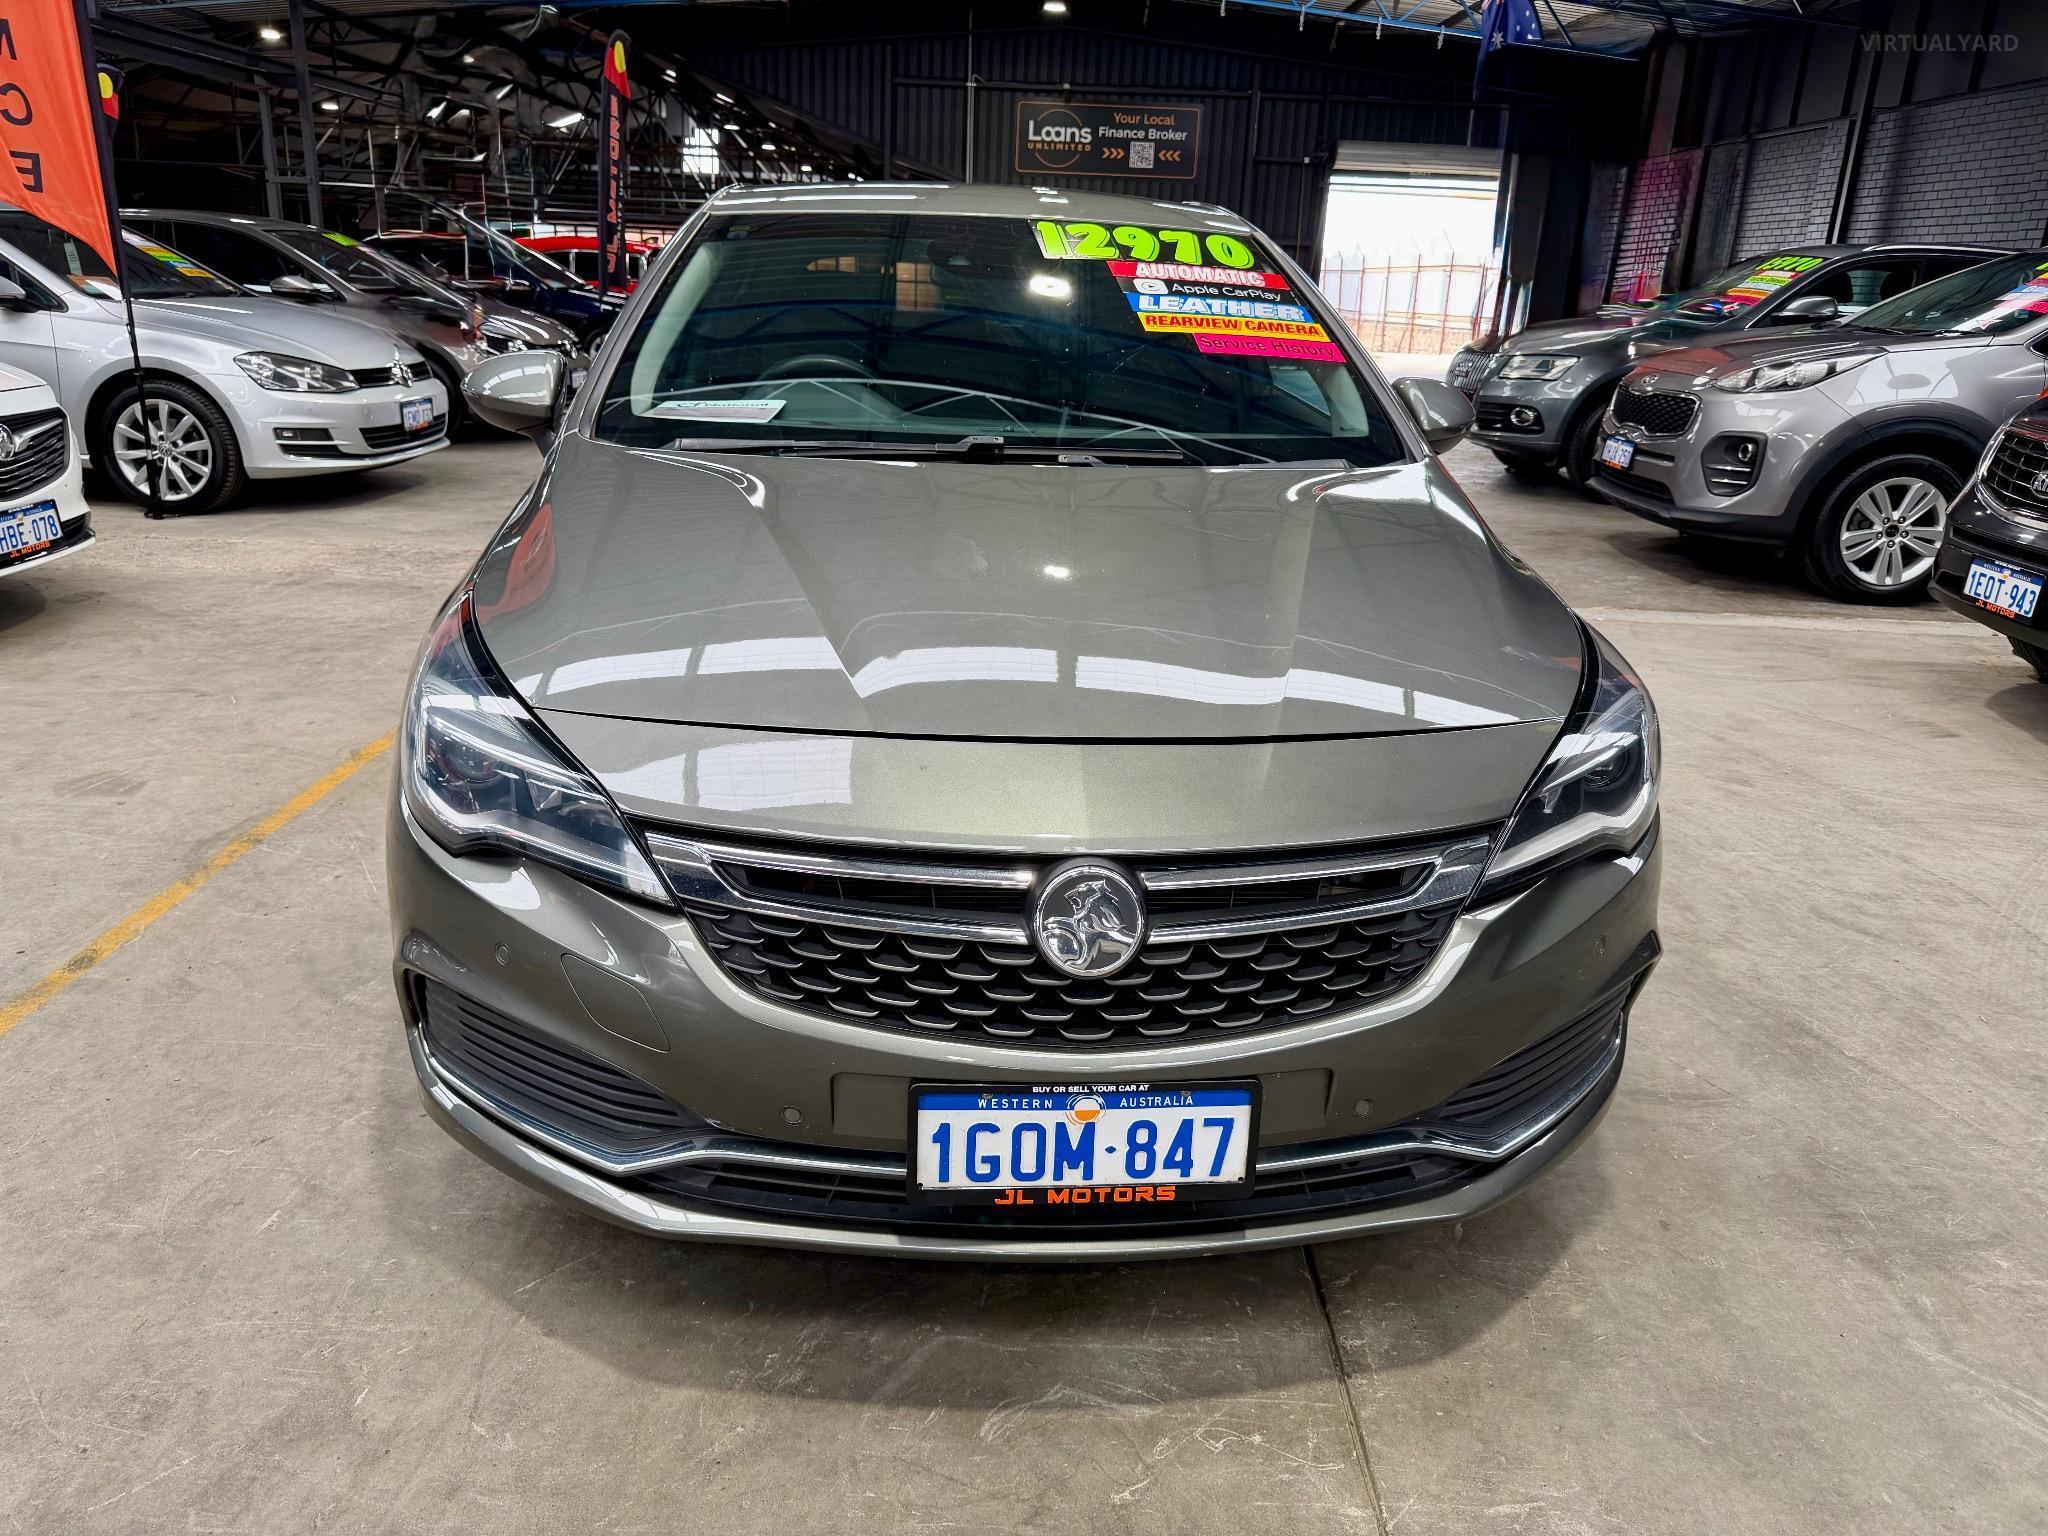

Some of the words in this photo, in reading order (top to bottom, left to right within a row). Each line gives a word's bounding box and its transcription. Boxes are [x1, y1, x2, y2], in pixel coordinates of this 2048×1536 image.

[1113, 112, 1140, 125] Your
[1143, 113, 1175, 125] Local
[1028, 120, 1092, 143] Loans
[1099, 126, 1145, 139] Finance
[1148, 129, 1188, 141] Broker
[1028, 142, 1092, 151] UNLIMITED
[1036, 222, 1255, 269] 12970
[1136, 262, 1266, 287] AUTOMATIC
[1172, 283, 1218, 297] Apple
[1222, 285, 1281, 301] CarPlay
[1139, 295, 1305, 321] LEATHER
[1145, 315, 1239, 330] REARVIEW
[1245, 320, 1321, 337] CAMERA
[1200, 337, 1266, 352] Service
[1274, 339, 1334, 358] History
[10, 550, 20, 558] JL
[21, 541, 51, 555] MOTORS
[1975, 599, 1985, 608] JL
[1986, 603, 2015, 619] MOTORS
[1068, 1085, 1090, 1093] SELL
[1091, 1085, 1117, 1093] YOUR
[1138, 1084, 1149, 1092] AT
[978, 1098, 1053, 1109] WESTERN
[1120, 1095, 1194, 1107] AUSTRALIA
[995, 1189, 1034, 1205] JL
[1048, 1186, 1176, 1204] MOTORS
